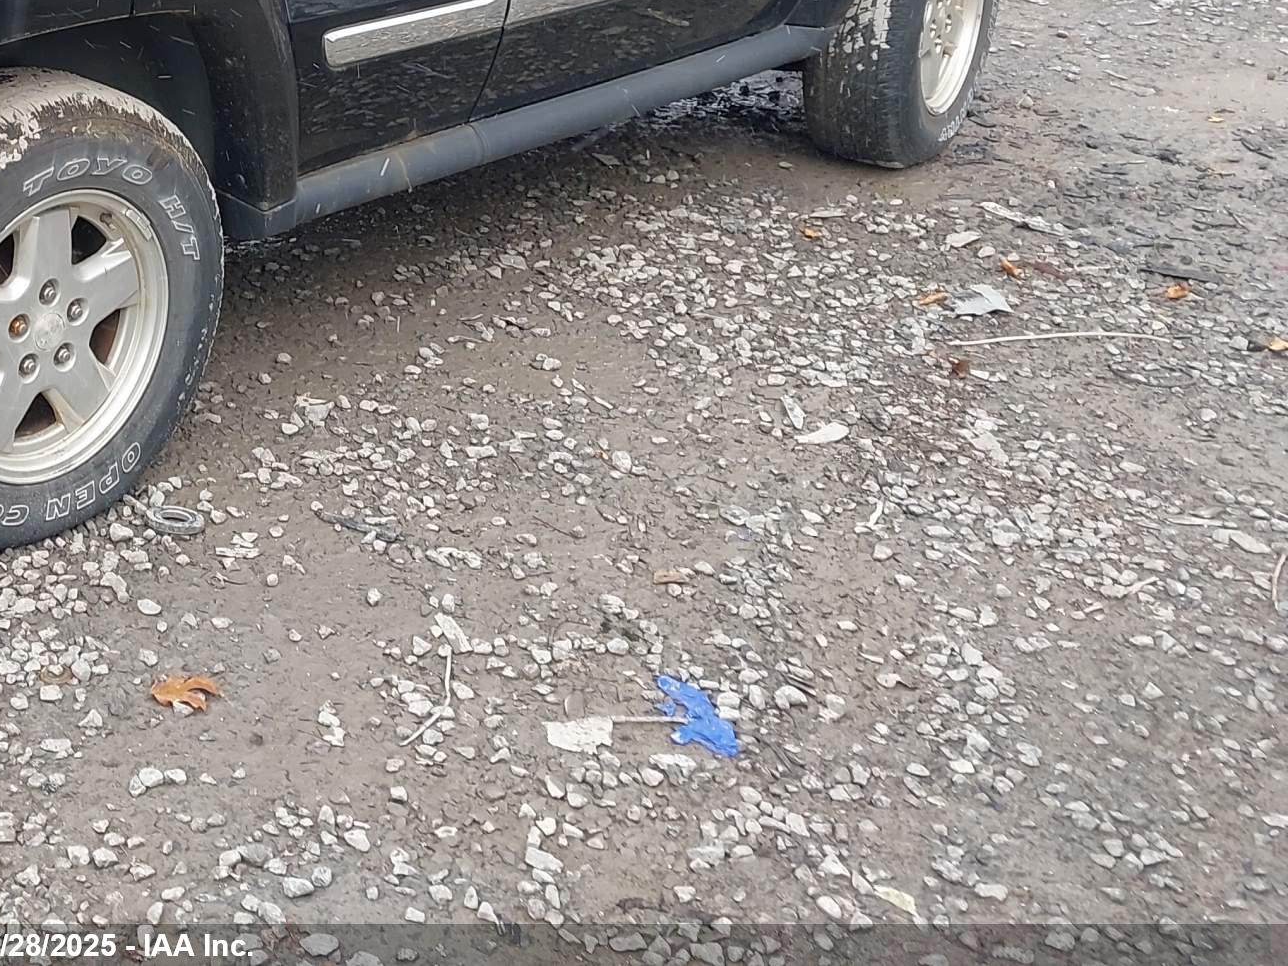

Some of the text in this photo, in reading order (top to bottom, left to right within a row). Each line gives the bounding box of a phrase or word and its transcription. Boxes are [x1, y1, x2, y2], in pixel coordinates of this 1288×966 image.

[23, 156, 201, 261] TOYO H/T
[46, 442, 141, 521] OPEN
